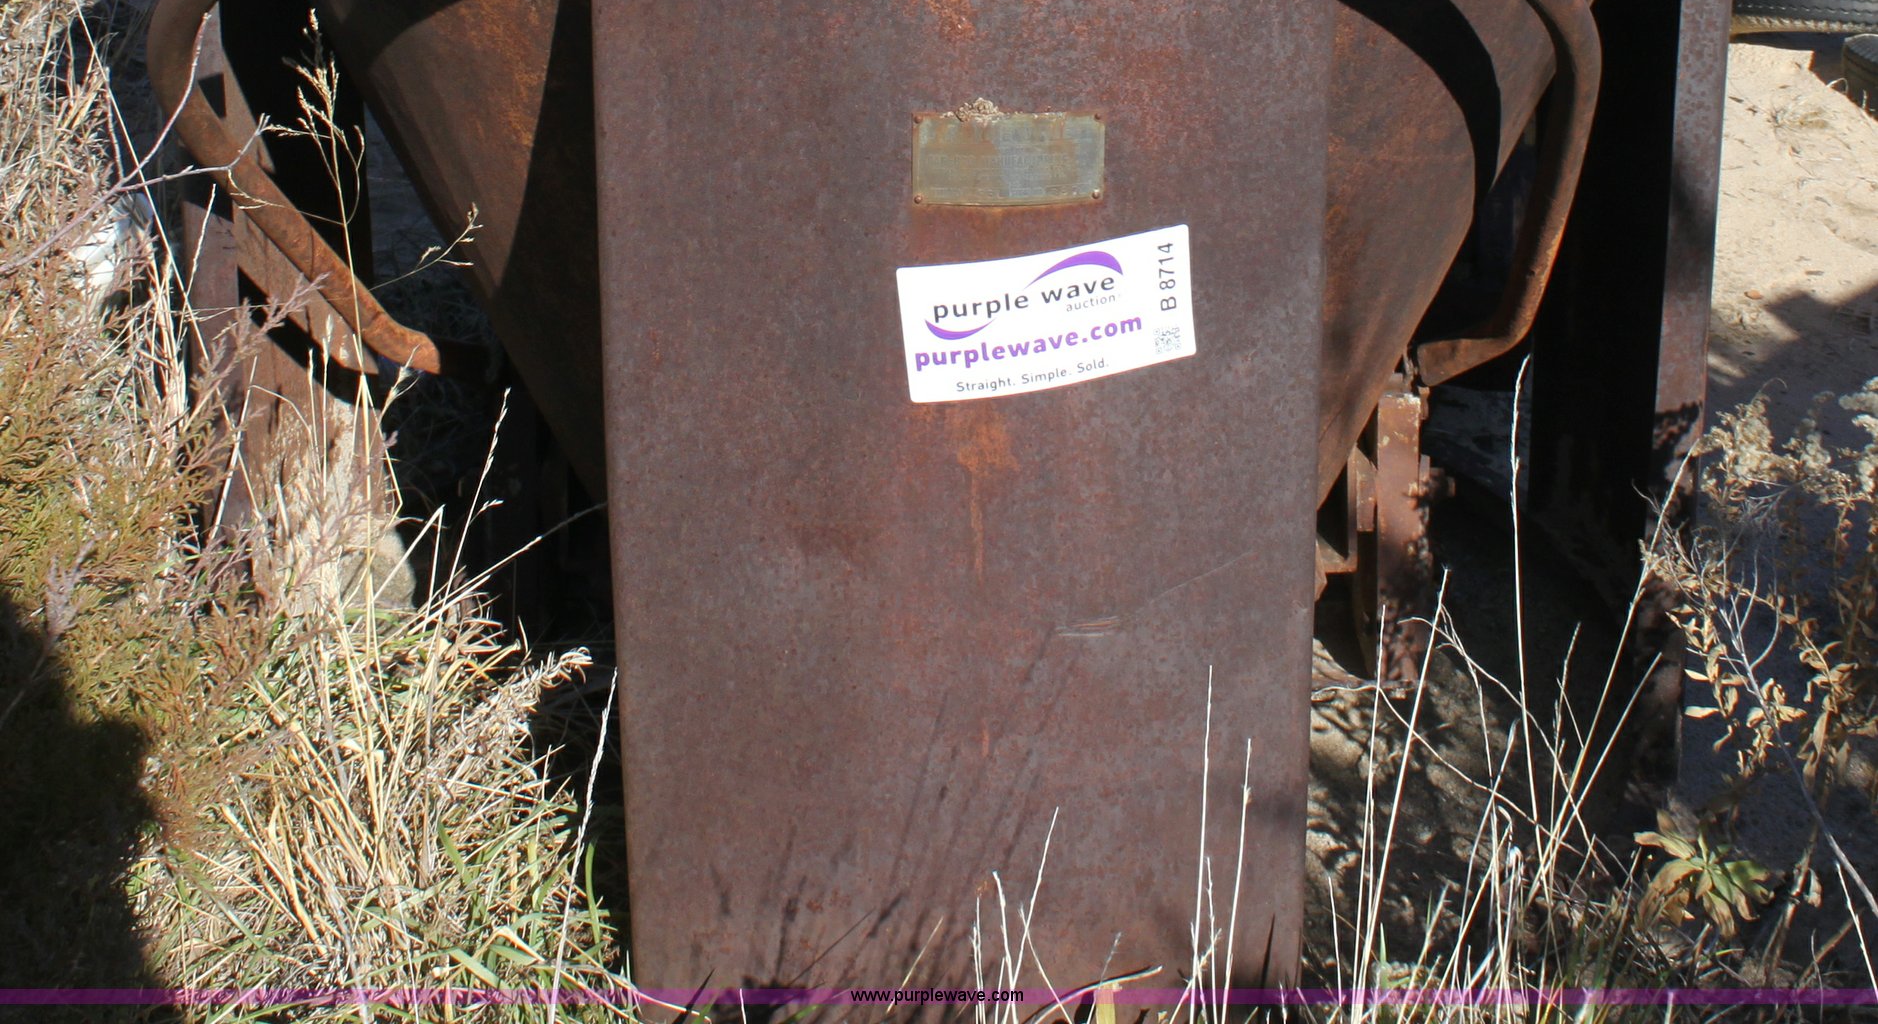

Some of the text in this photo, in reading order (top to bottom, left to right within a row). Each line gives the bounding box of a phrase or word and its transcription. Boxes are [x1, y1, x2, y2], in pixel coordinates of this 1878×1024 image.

[933, 276, 1115, 323] purple wave
[1065, 293, 1116, 313] auction
[915, 316, 1142, 371] purplewave.com
[956, 357, 1110, 393] Straight. Simple. Sold.
